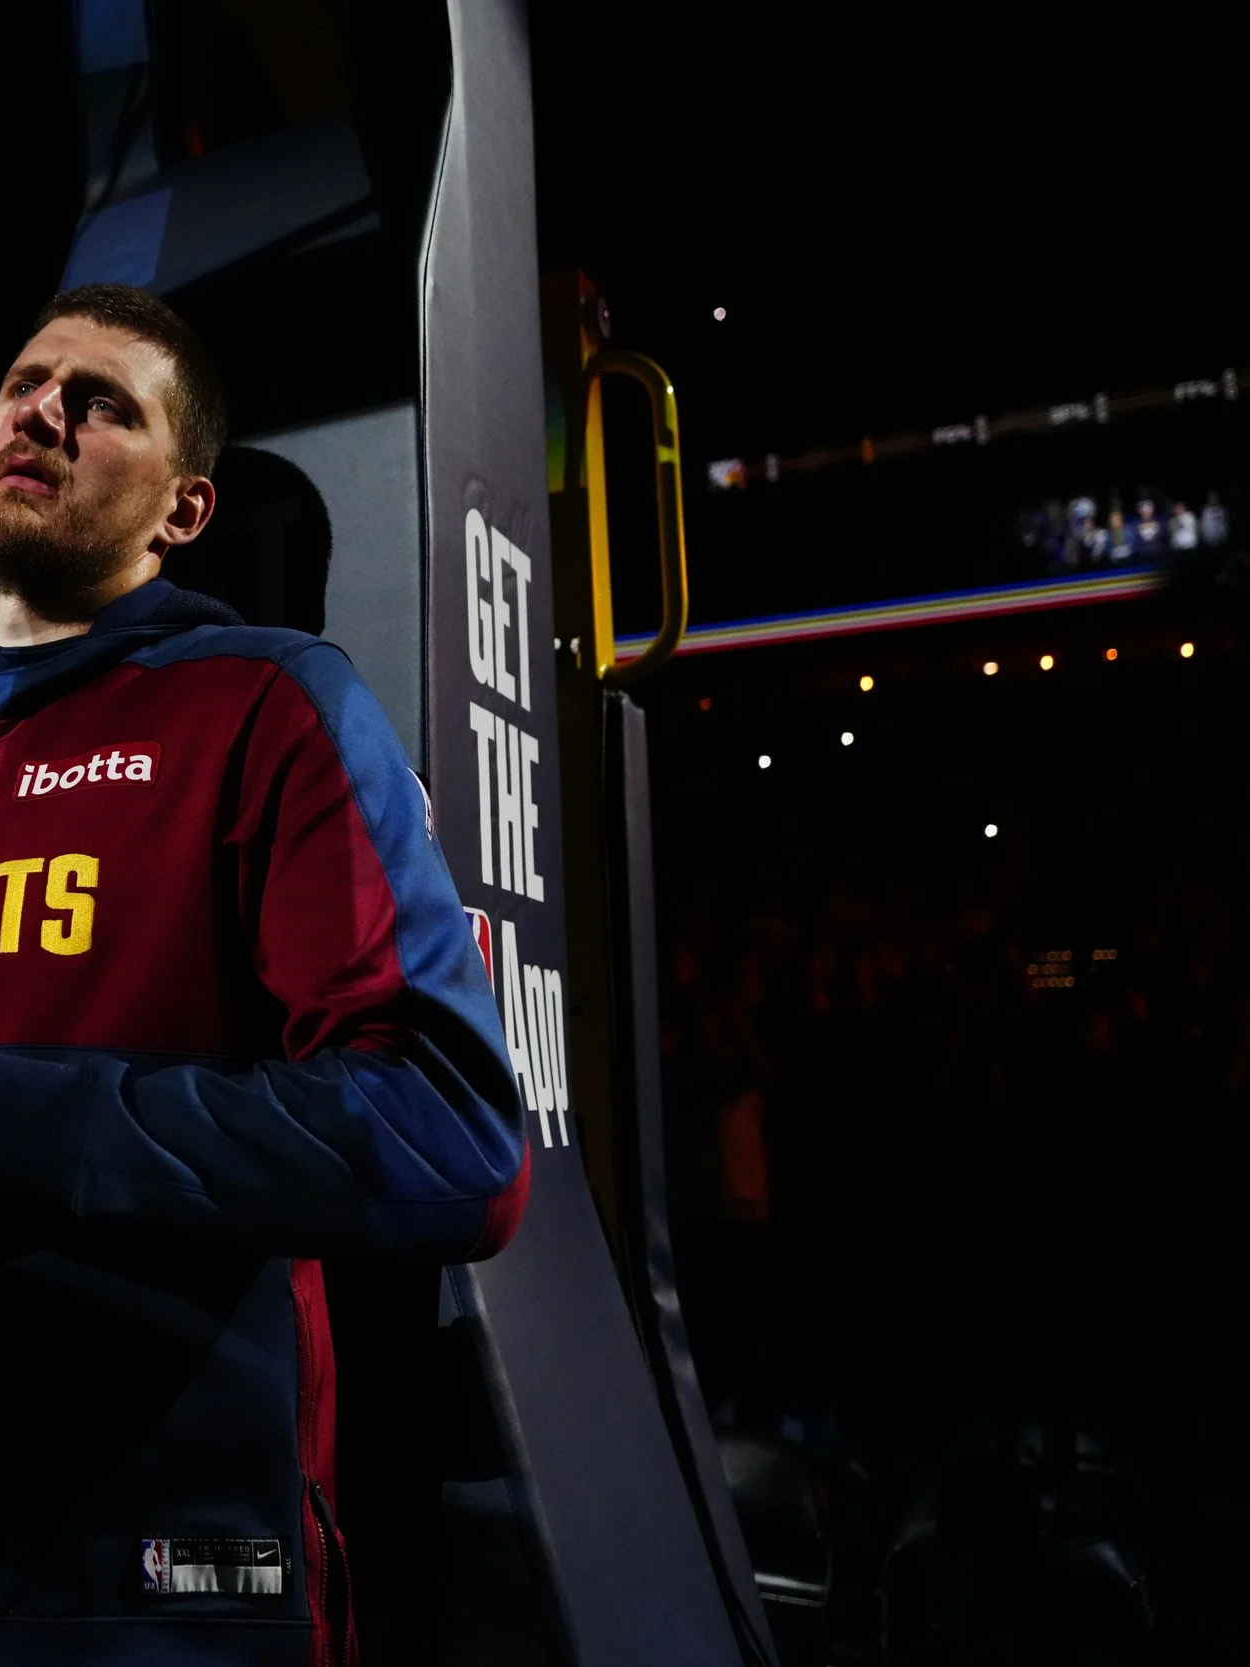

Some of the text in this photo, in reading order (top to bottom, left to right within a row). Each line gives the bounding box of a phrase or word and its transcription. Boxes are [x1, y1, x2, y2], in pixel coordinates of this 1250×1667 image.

[465, 508, 533, 712] GET
[17, 751, 152, 797] ibotta
[469, 701, 545, 903] THE
[502, 920, 569, 1148] App
